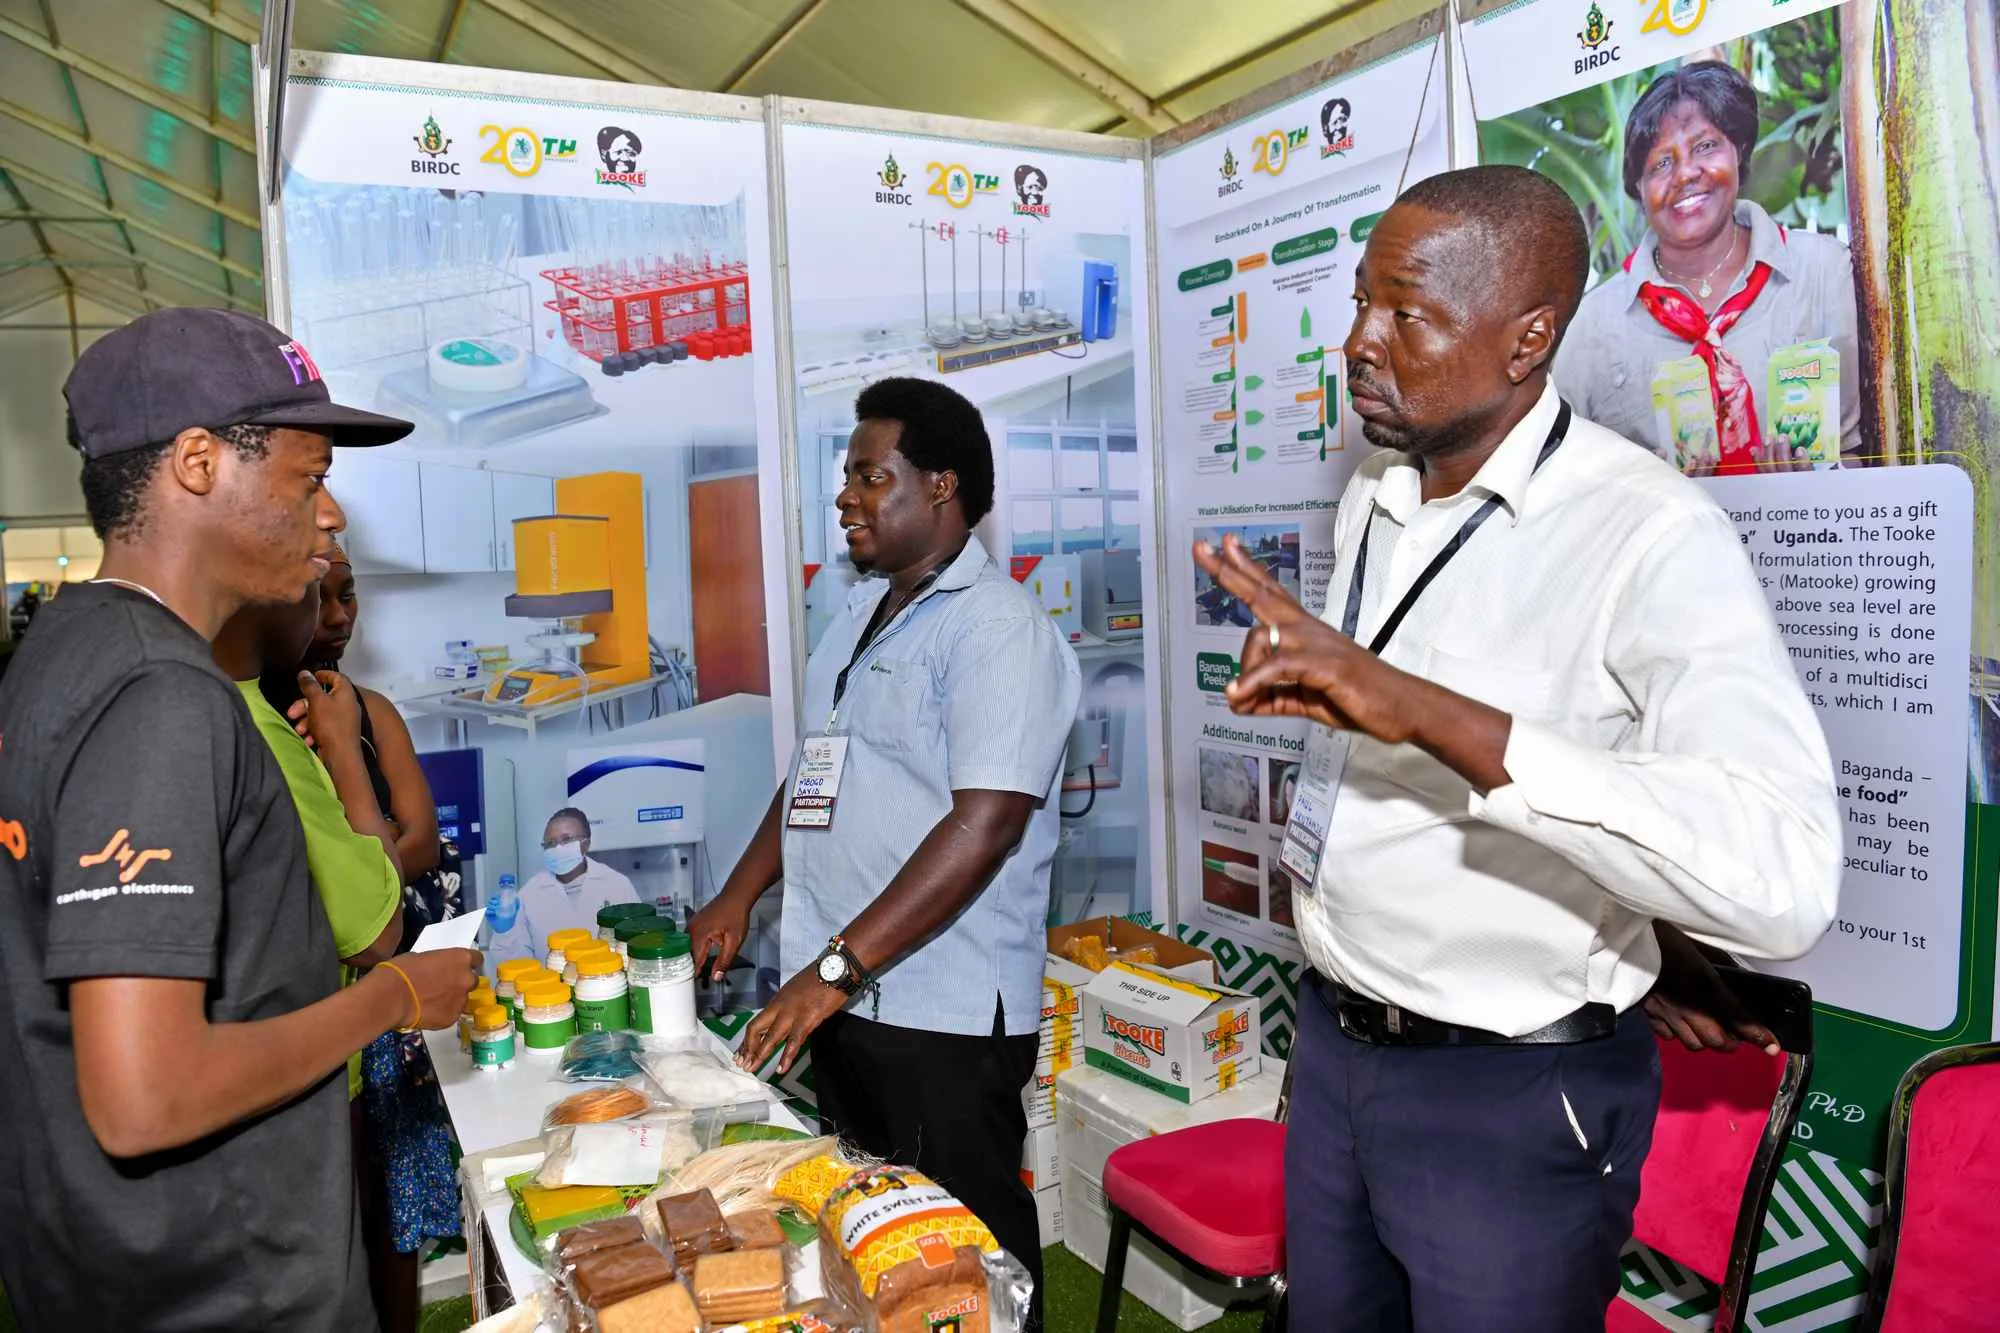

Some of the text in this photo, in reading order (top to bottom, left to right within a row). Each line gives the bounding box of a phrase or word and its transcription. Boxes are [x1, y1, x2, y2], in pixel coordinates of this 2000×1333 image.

[1574, 46, 1621, 75] BIRDC
[411, 160, 460, 175] BIRDC
[601, 171, 646, 185] TOOKE
[875, 192, 912, 206] BIRDC
[1218, 180, 1244, 198] BIRDC
[1215, 183, 1382, 243] Embarked On A Journey Of Transformation
[1318, 237, 1335, 251] Stage
[1198, 507, 1219, 516] Waste
[1220, 504, 1254, 515] Utilisation
[1255, 503, 1267, 513] For
[1268, 502, 1304, 512] Increased
[1723, 501, 1938, 523] rand come to you as a gift
[1773, 528, 1844, 548] Uganda.
[1849, 526, 1879, 541] The
[1883, 526, 1936, 541] Tooke
[1305, 561, 1335, 573] of energ
[1759, 551, 1852, 567] formulation
[1858, 551, 1936, 571] through,
[1780, 574, 1859, 591] (Matooke)
[1865, 576, 1936, 594] growing
[1775, 596, 1936, 616] above sea level are
[1869, 623, 1881, 638] is
[1891, 624, 1936, 641] done
[1787, 645, 1935, 666] munities, who are
[1199, 660, 1231, 675] Banana
[1203, 673, 1227, 686] Peels
[1806, 668, 1928, 690] of a multidisci
[1835, 694, 1884, 711] which
[1893, 697, 1898, 712] I
[1906, 702, 1933, 715] am
[1203, 723, 1304, 751] Additional non food
[1841, 760, 1913, 782] Baganda
[795, 798, 830, 807] PARTICIPANT
[1849, 807, 1930, 833] has been
[1857, 835, 1930, 857] may be
[1910, 866, 1928, 881] to
[121, 883, 194, 895] electronics
[1839, 919, 1854, 933] to
[1859, 925, 1896, 943] your
[1902, 931, 1926, 949] 1st
[1119, 981, 1138, 992] THIS
[1137, 988, 1157, 999] SIDE
[1157, 993, 1170, 1002] UP
[1105, 1013, 1165, 1057] TOOKE
[846, 1210, 881, 1243] WHITE
[882, 1197, 922, 1212] SWEET
[928, 1297, 977, 1322] TOOKE
